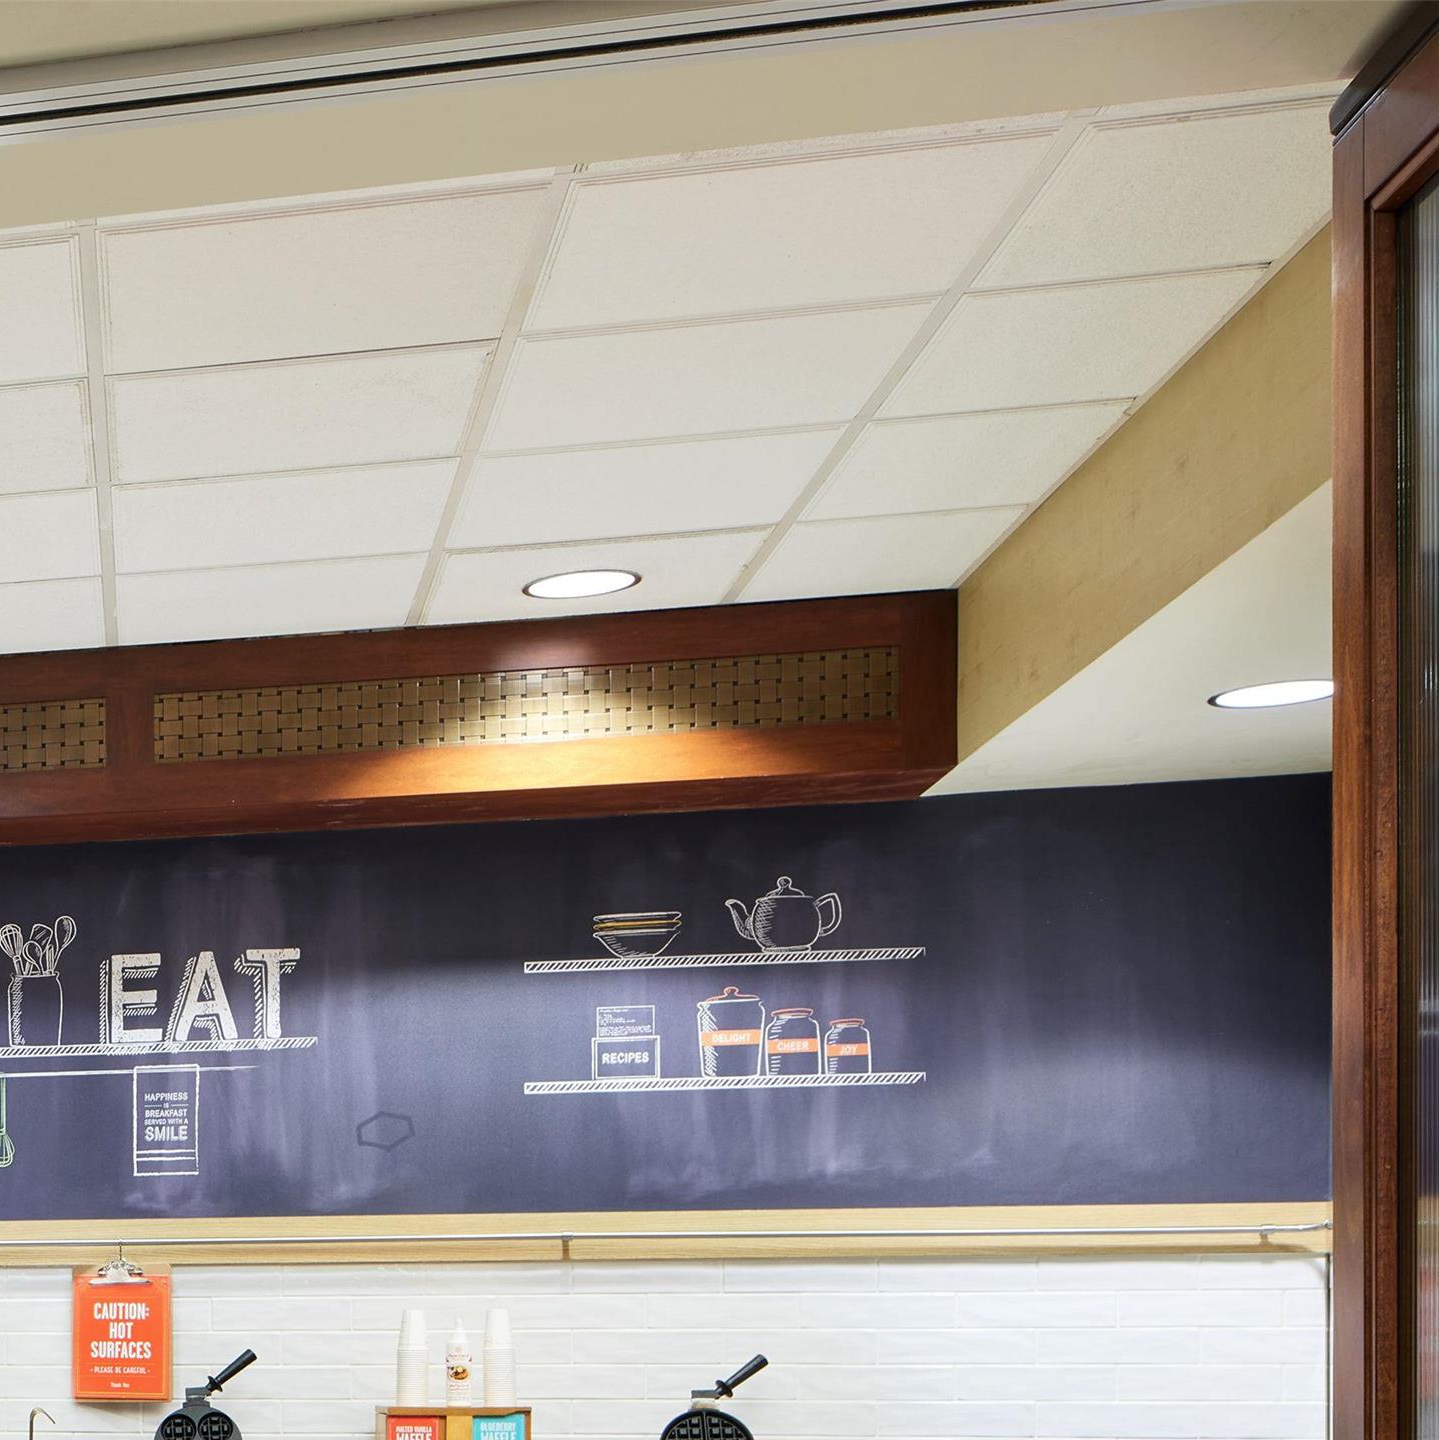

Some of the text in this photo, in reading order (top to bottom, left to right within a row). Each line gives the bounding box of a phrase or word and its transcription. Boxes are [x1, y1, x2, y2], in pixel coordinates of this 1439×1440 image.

[110, 948, 300, 1043] EAT
[712, 1033, 751, 1043] DELIGHT
[777, 1041, 809, 1052] CHEER
[839, 1044, 857, 1056] JOY
[602, 1051, 650, 1065] RECIPES
[144, 1092, 188, 1102] HAPPINESS
[145, 1109, 188, 1118] BREAKFAST
[144, 1125, 188, 1141] SMILE
[94, 1302, 150, 1320] CAUTION:
[109, 1322, 133, 1339] HOT
[90, 1341, 151, 1359] SURFACES
[480, 1422, 516, 1432] BLUEBERRY
